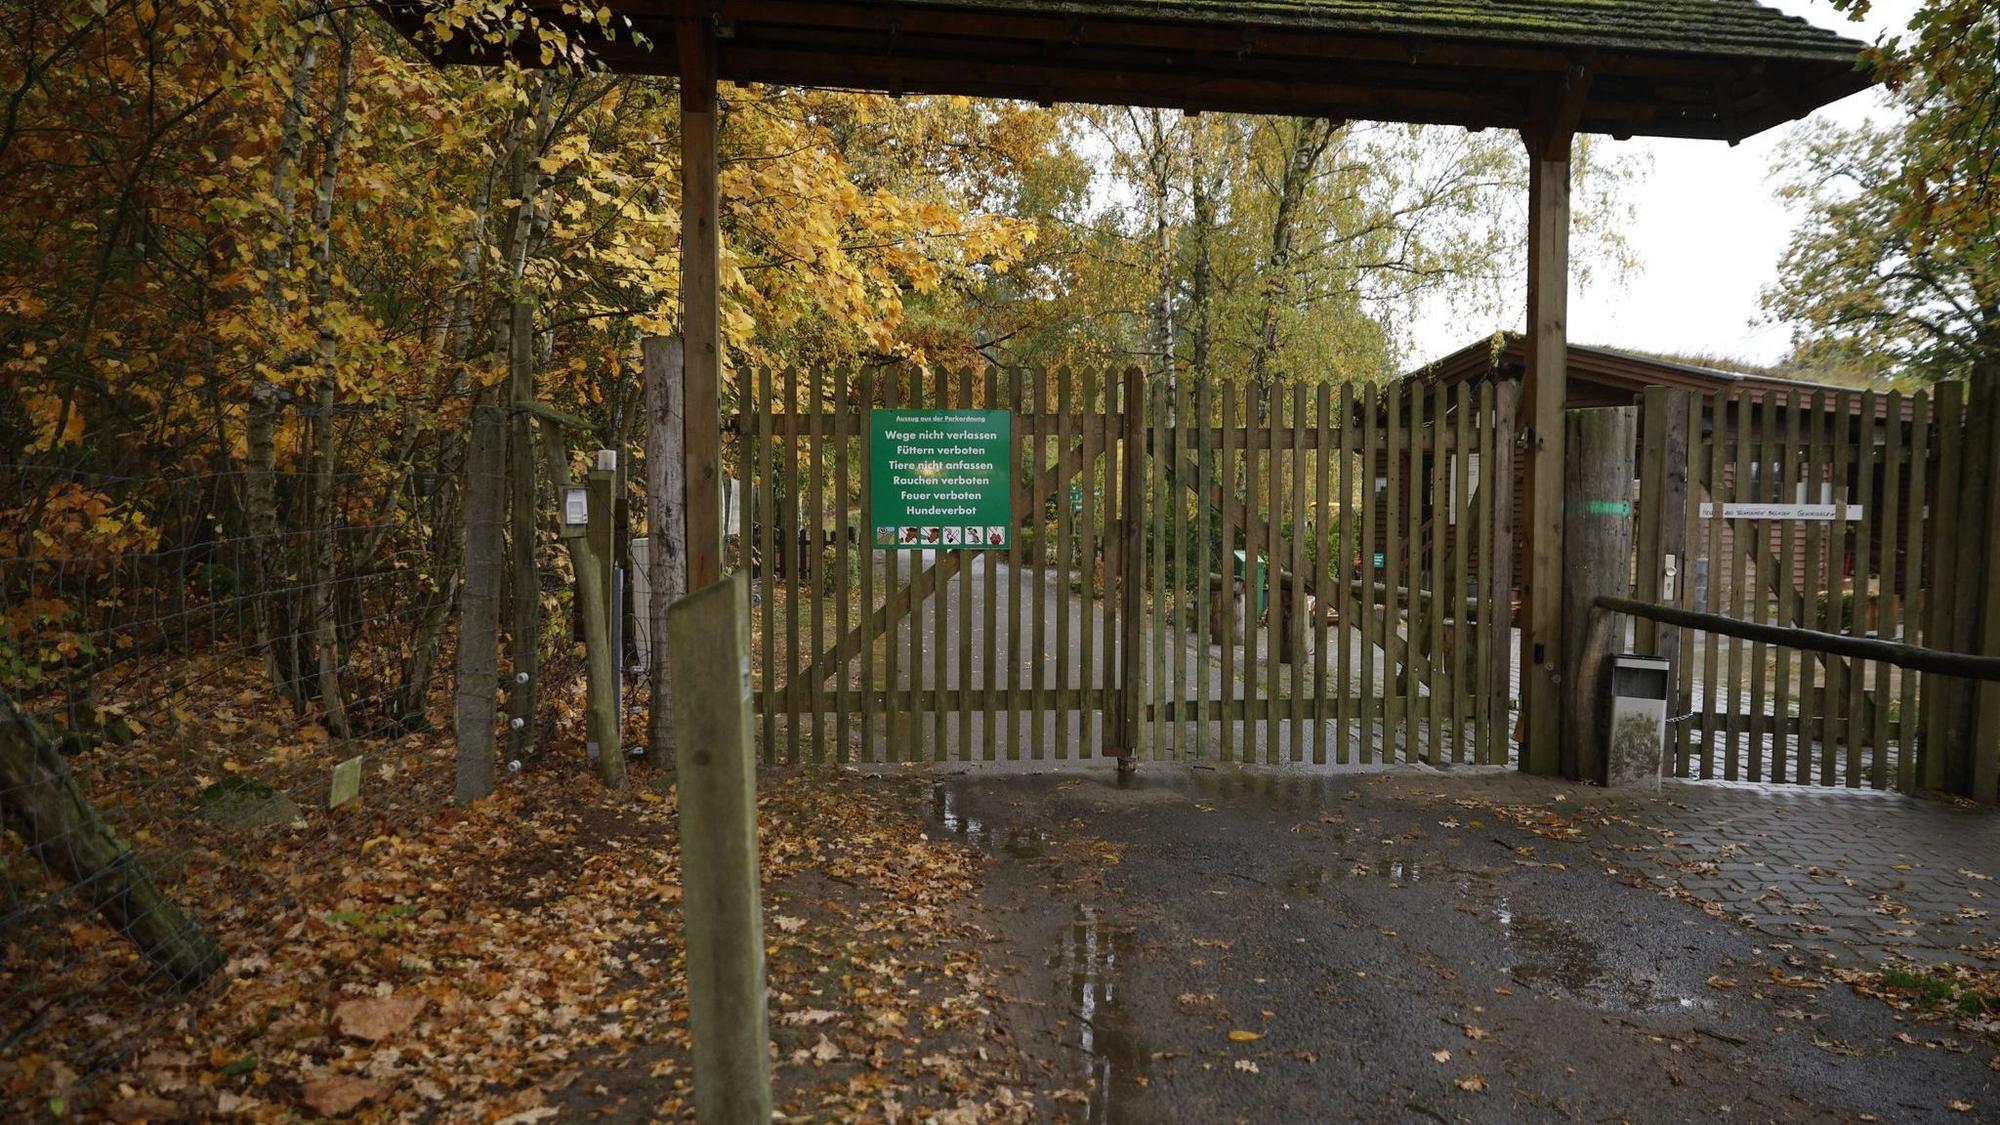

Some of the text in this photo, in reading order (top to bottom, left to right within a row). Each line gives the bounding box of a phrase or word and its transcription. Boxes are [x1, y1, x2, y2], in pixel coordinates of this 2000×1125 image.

[885, 430, 996, 441] Wege nicht verlassen
[897, 446, 985, 455] Füttern verboten
[889, 461, 992, 470] Tiere nicht anfassen
[894, 476, 989, 485] Rauchen verboten
[901, 491, 982, 500] Feuer verboten
[906, 506, 976, 515] Hundeverbot
